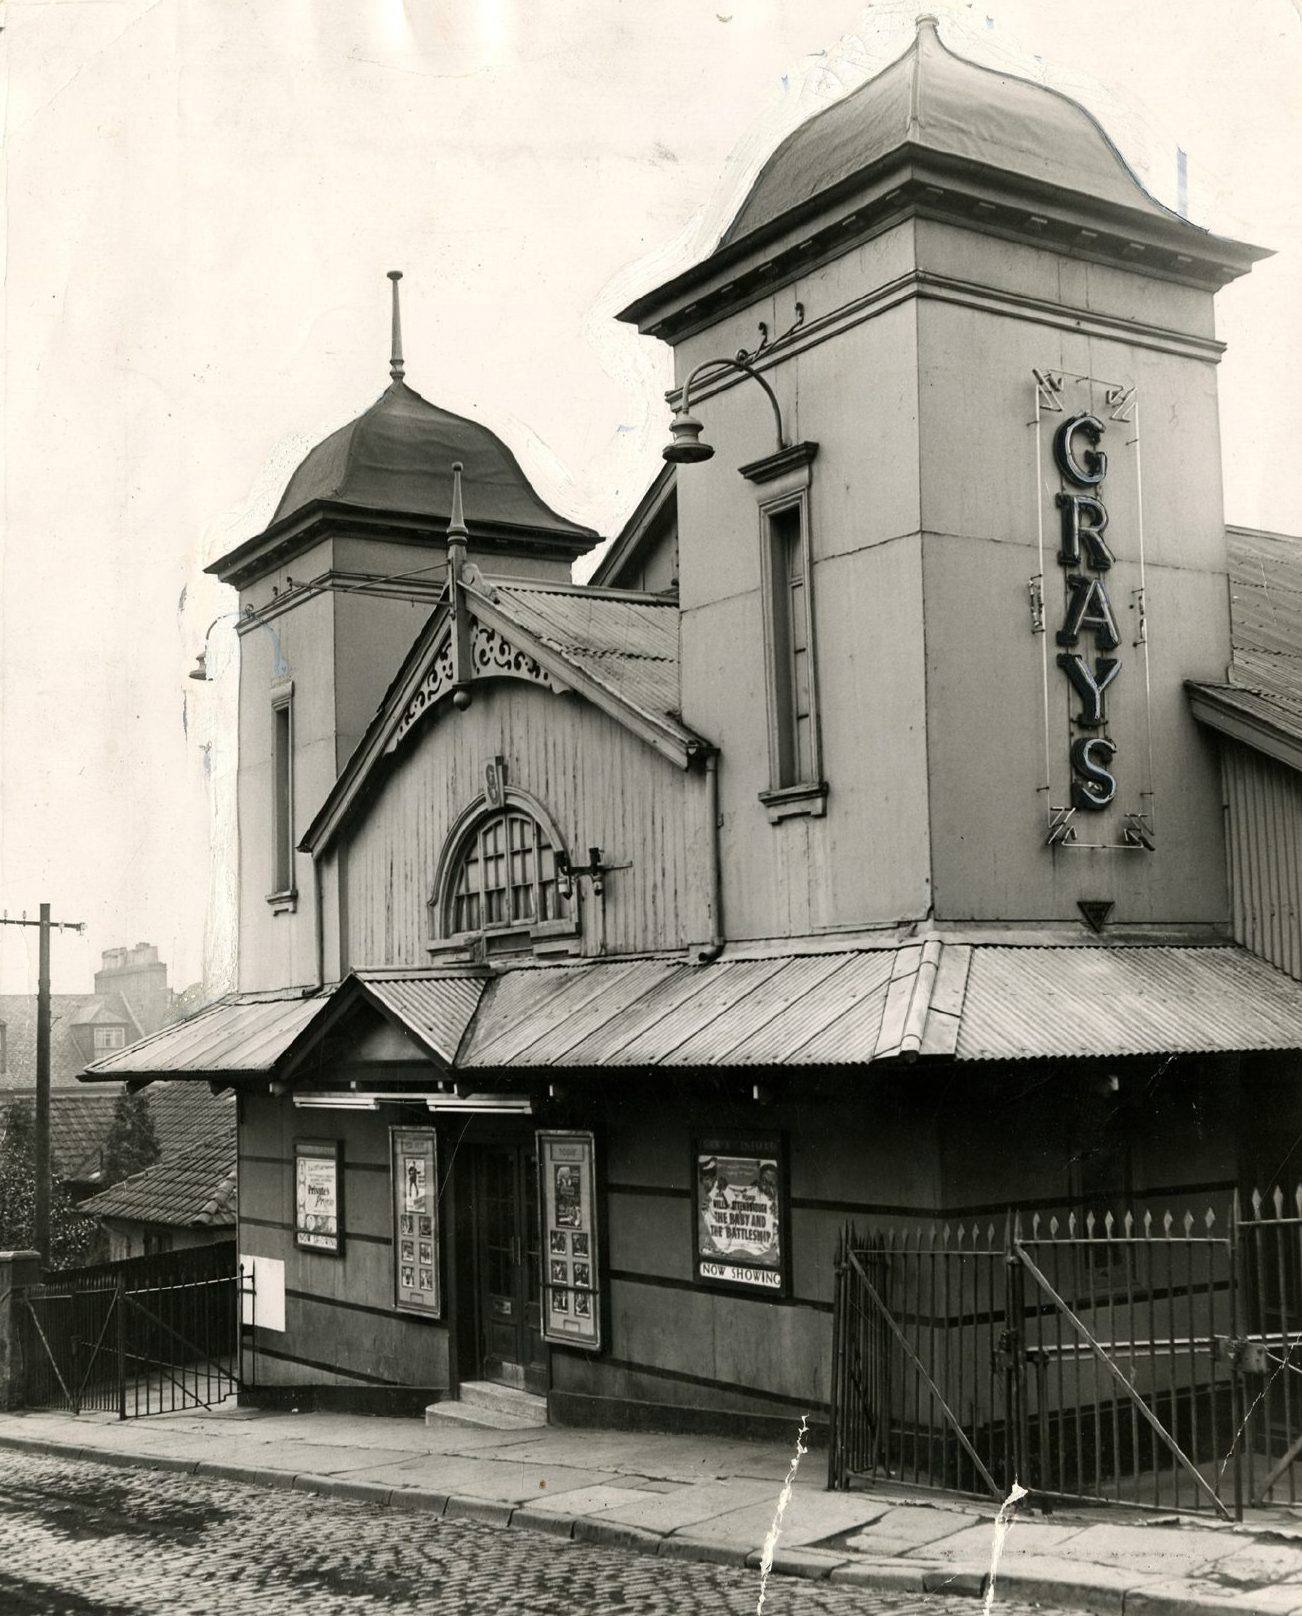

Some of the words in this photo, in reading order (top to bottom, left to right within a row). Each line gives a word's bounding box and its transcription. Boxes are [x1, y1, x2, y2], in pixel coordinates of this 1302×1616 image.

[1053, 410, 1123, 812] GRAYS
[714, 1211, 728, 1224] THE
[729, 1213, 750, 1226] BABY
[751, 1215, 767, 1228] AND
[710, 1225, 723, 1237] THE
[725, 1226, 771, 1243] BATTLESHIP
[703, 1264, 725, 1277] NOW
[731, 1268, 781, 1286] SHOWING
